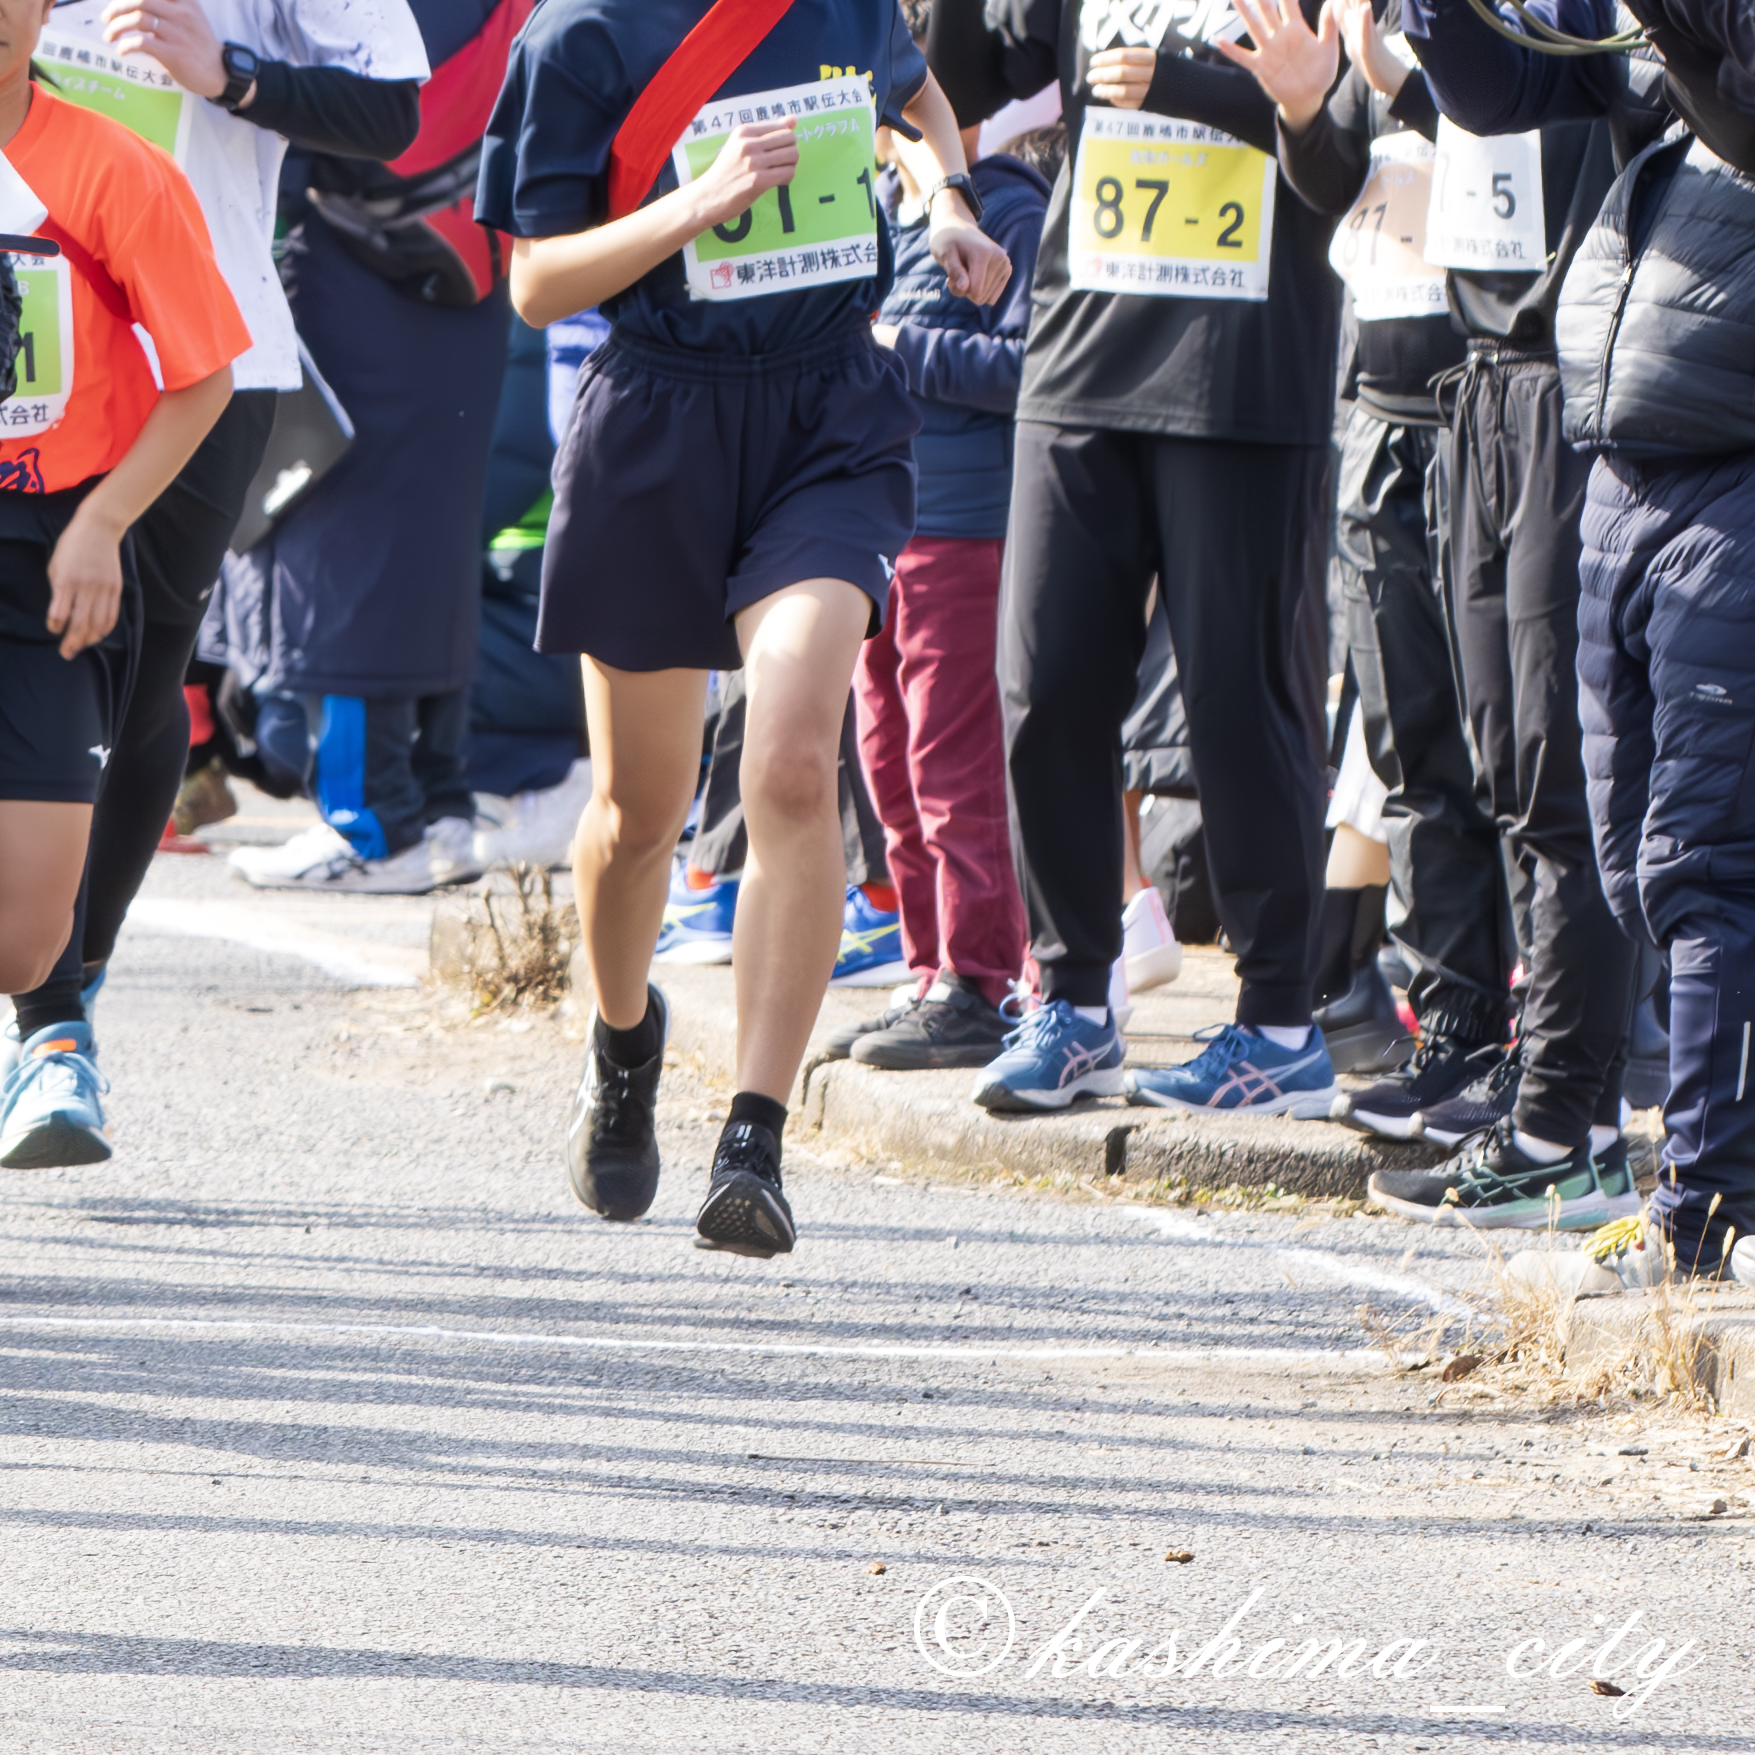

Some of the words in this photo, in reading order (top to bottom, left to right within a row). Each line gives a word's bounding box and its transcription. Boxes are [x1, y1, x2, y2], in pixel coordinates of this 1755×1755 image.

[1106, 261, 1246, 289] 東洋計測株式会社
